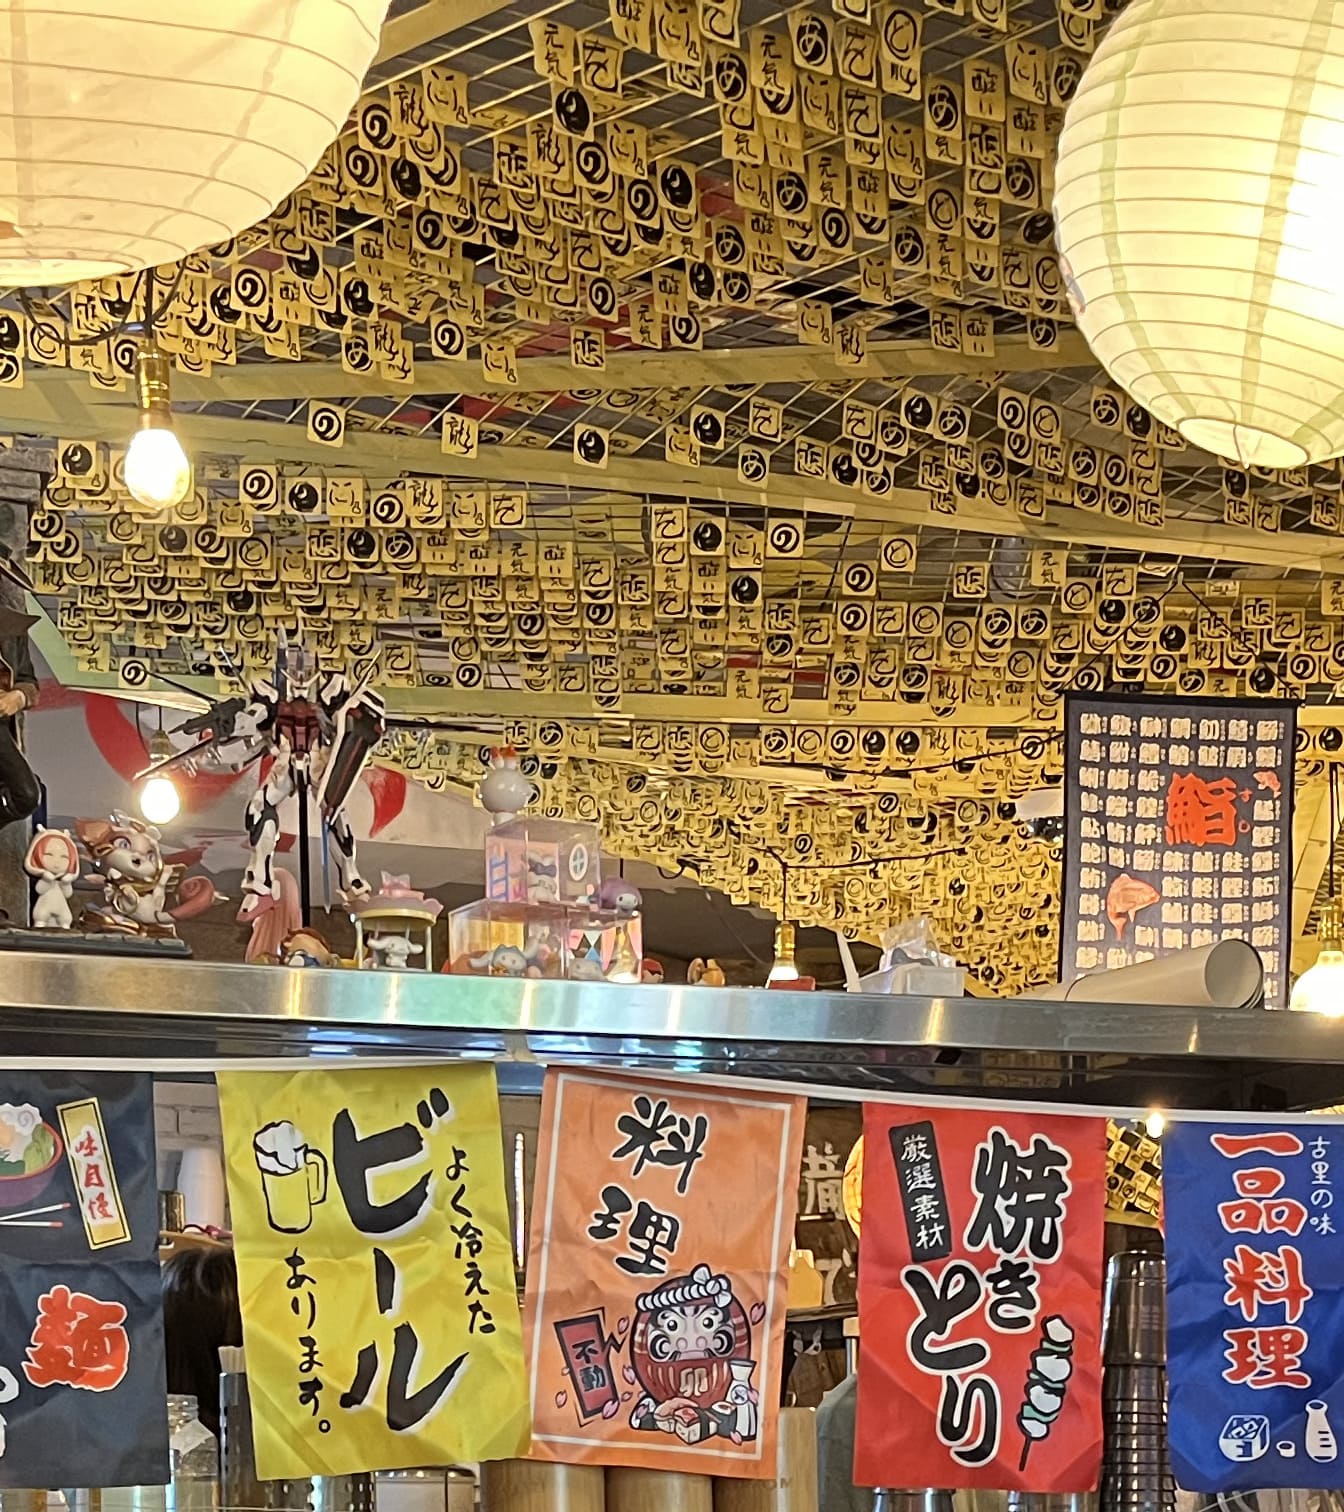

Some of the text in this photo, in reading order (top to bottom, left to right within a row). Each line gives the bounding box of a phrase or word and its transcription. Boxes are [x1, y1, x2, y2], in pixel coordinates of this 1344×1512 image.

[75, 1130, 116, 1222] 味自慢
[445, 1146, 498, 1335] よく冷えた
[588, 1095, 708, 1277] 料理
[901, 1134, 945, 1250] 厳選素材
[1308, 1136, 1337, 1235] 古里の味
[332, 1086, 470, 1434] ビール
[1210, 1131, 1313, 1390] 一品料理
[22, 1284, 130, 1393] 麺
